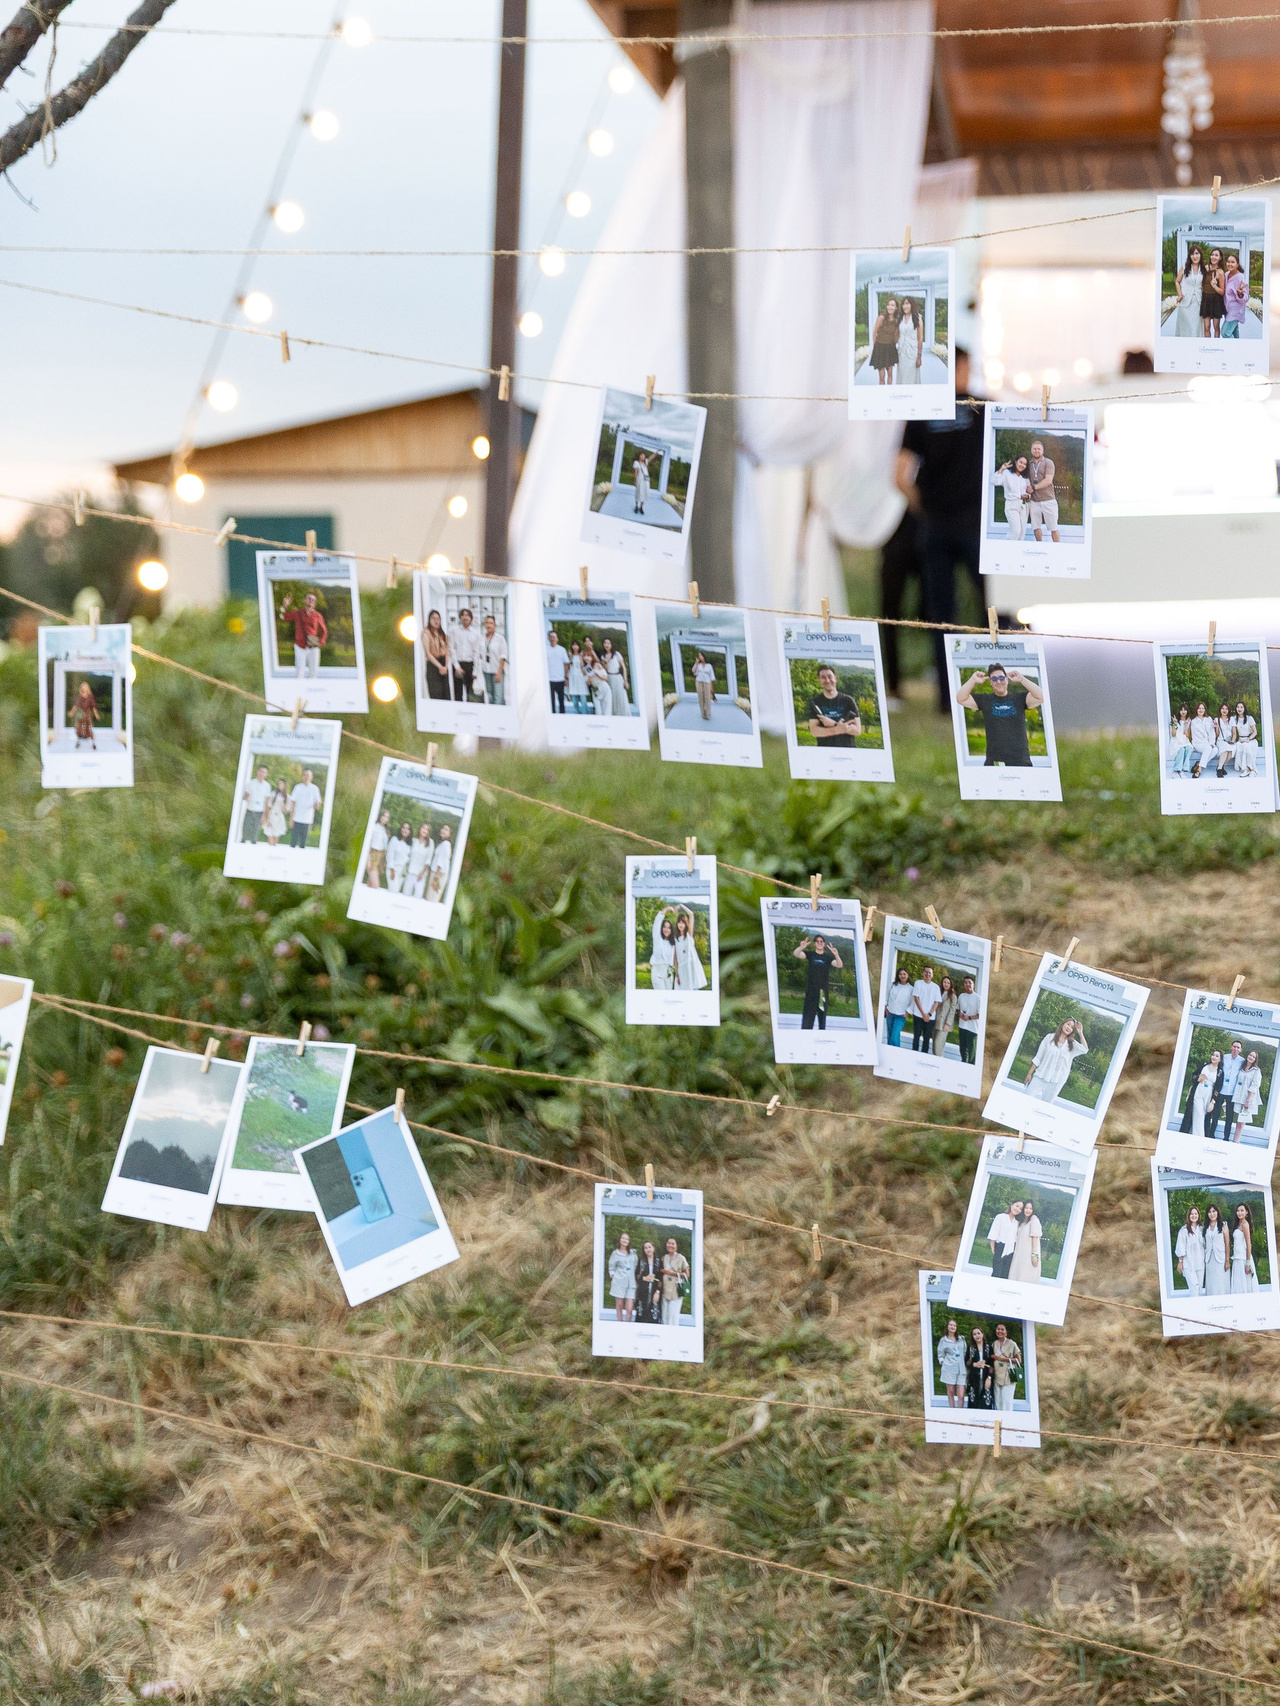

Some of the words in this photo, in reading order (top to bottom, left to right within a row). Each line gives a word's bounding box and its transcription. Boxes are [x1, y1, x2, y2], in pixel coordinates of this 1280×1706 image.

[405, 770, 426, 782] OPPO
[789, 902, 809, 910] OPPO
[917, 933, 936, 943] OPPO
[937, 937, 960, 947] eno14
[1067, 971, 1090, 984] OPPO
[1089, 978, 1115, 991] Reno14
[1238, 1008, 1264, 1018] Reno14
[1015, 1154, 1036, 1164] OPPO
[1036, 1157, 1061, 1167] Reno14
[625, 1190, 646, 1199] OPPO
[647, 1192, 672, 1200] eno14
